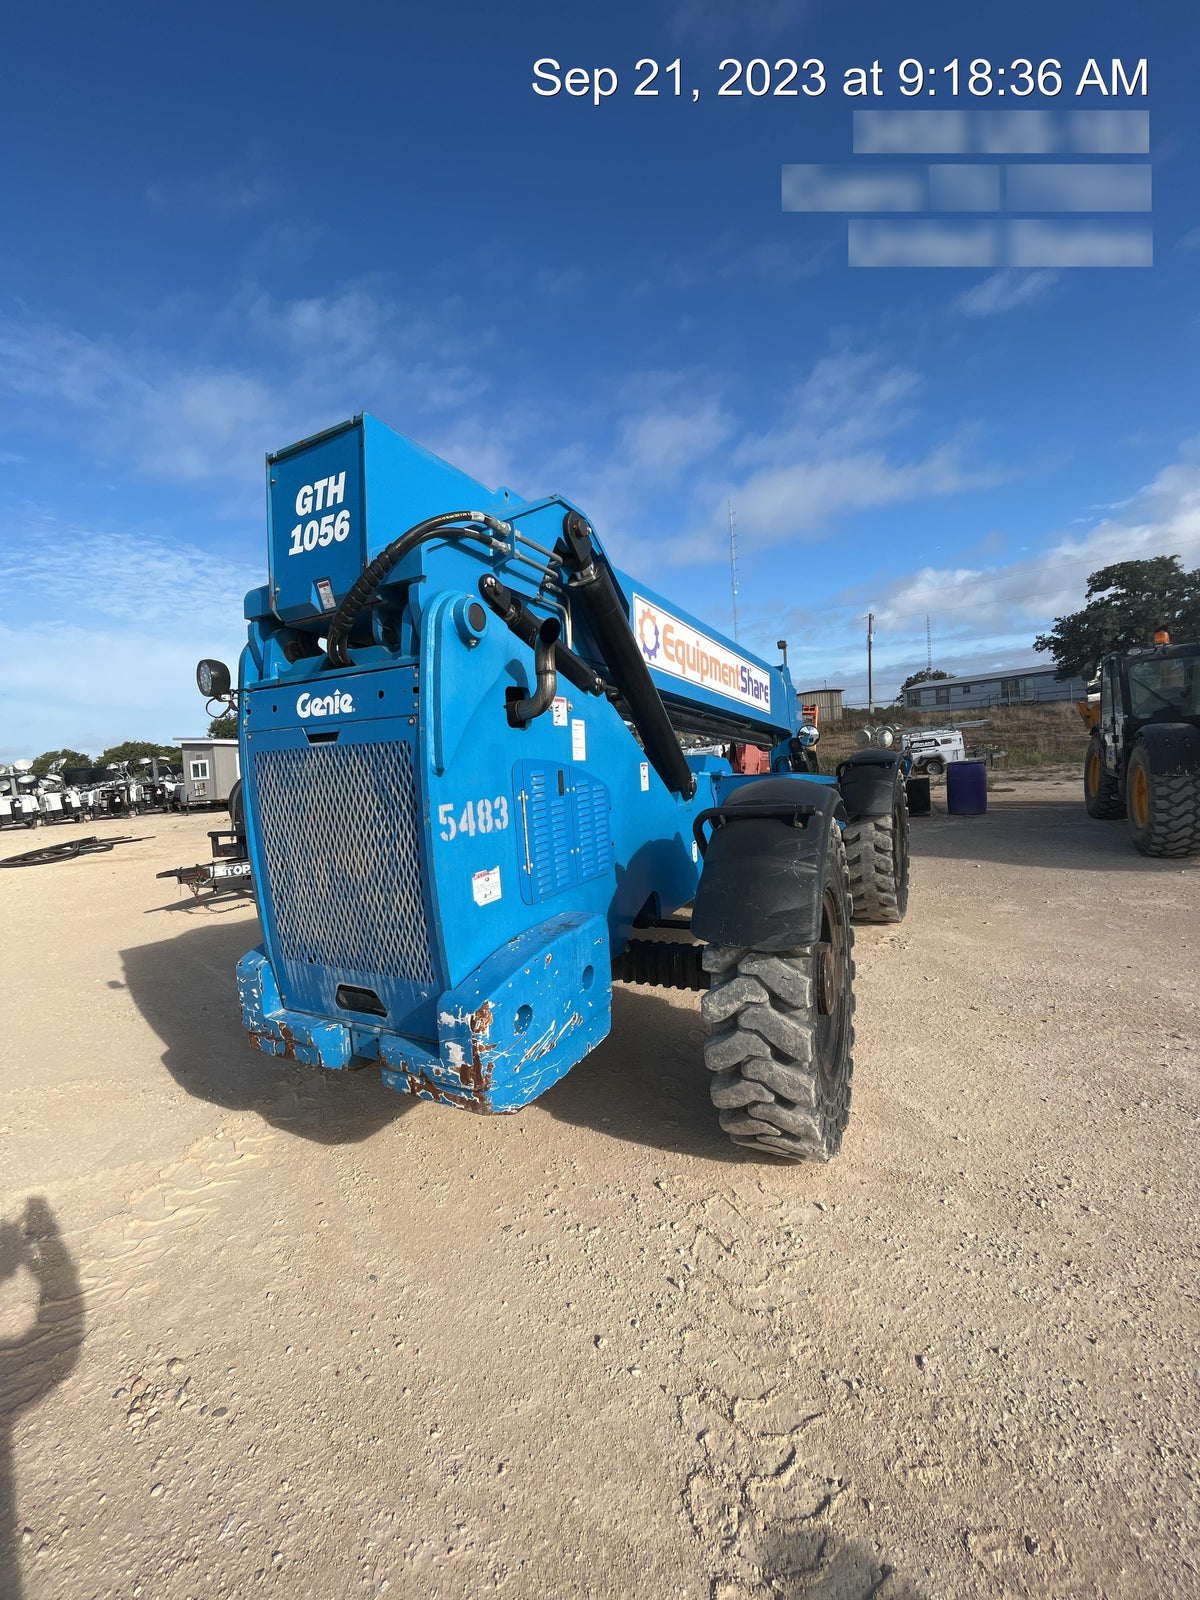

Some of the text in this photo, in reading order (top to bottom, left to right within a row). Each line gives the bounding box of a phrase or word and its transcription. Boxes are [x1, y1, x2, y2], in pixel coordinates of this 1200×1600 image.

[295, 470, 346, 516] GTH
[288, 509, 350, 556] 1056
[662, 623, 769, 704] EquipmentShare
[296, 688, 354, 718] Genie
[438, 795, 509, 841] 5483
